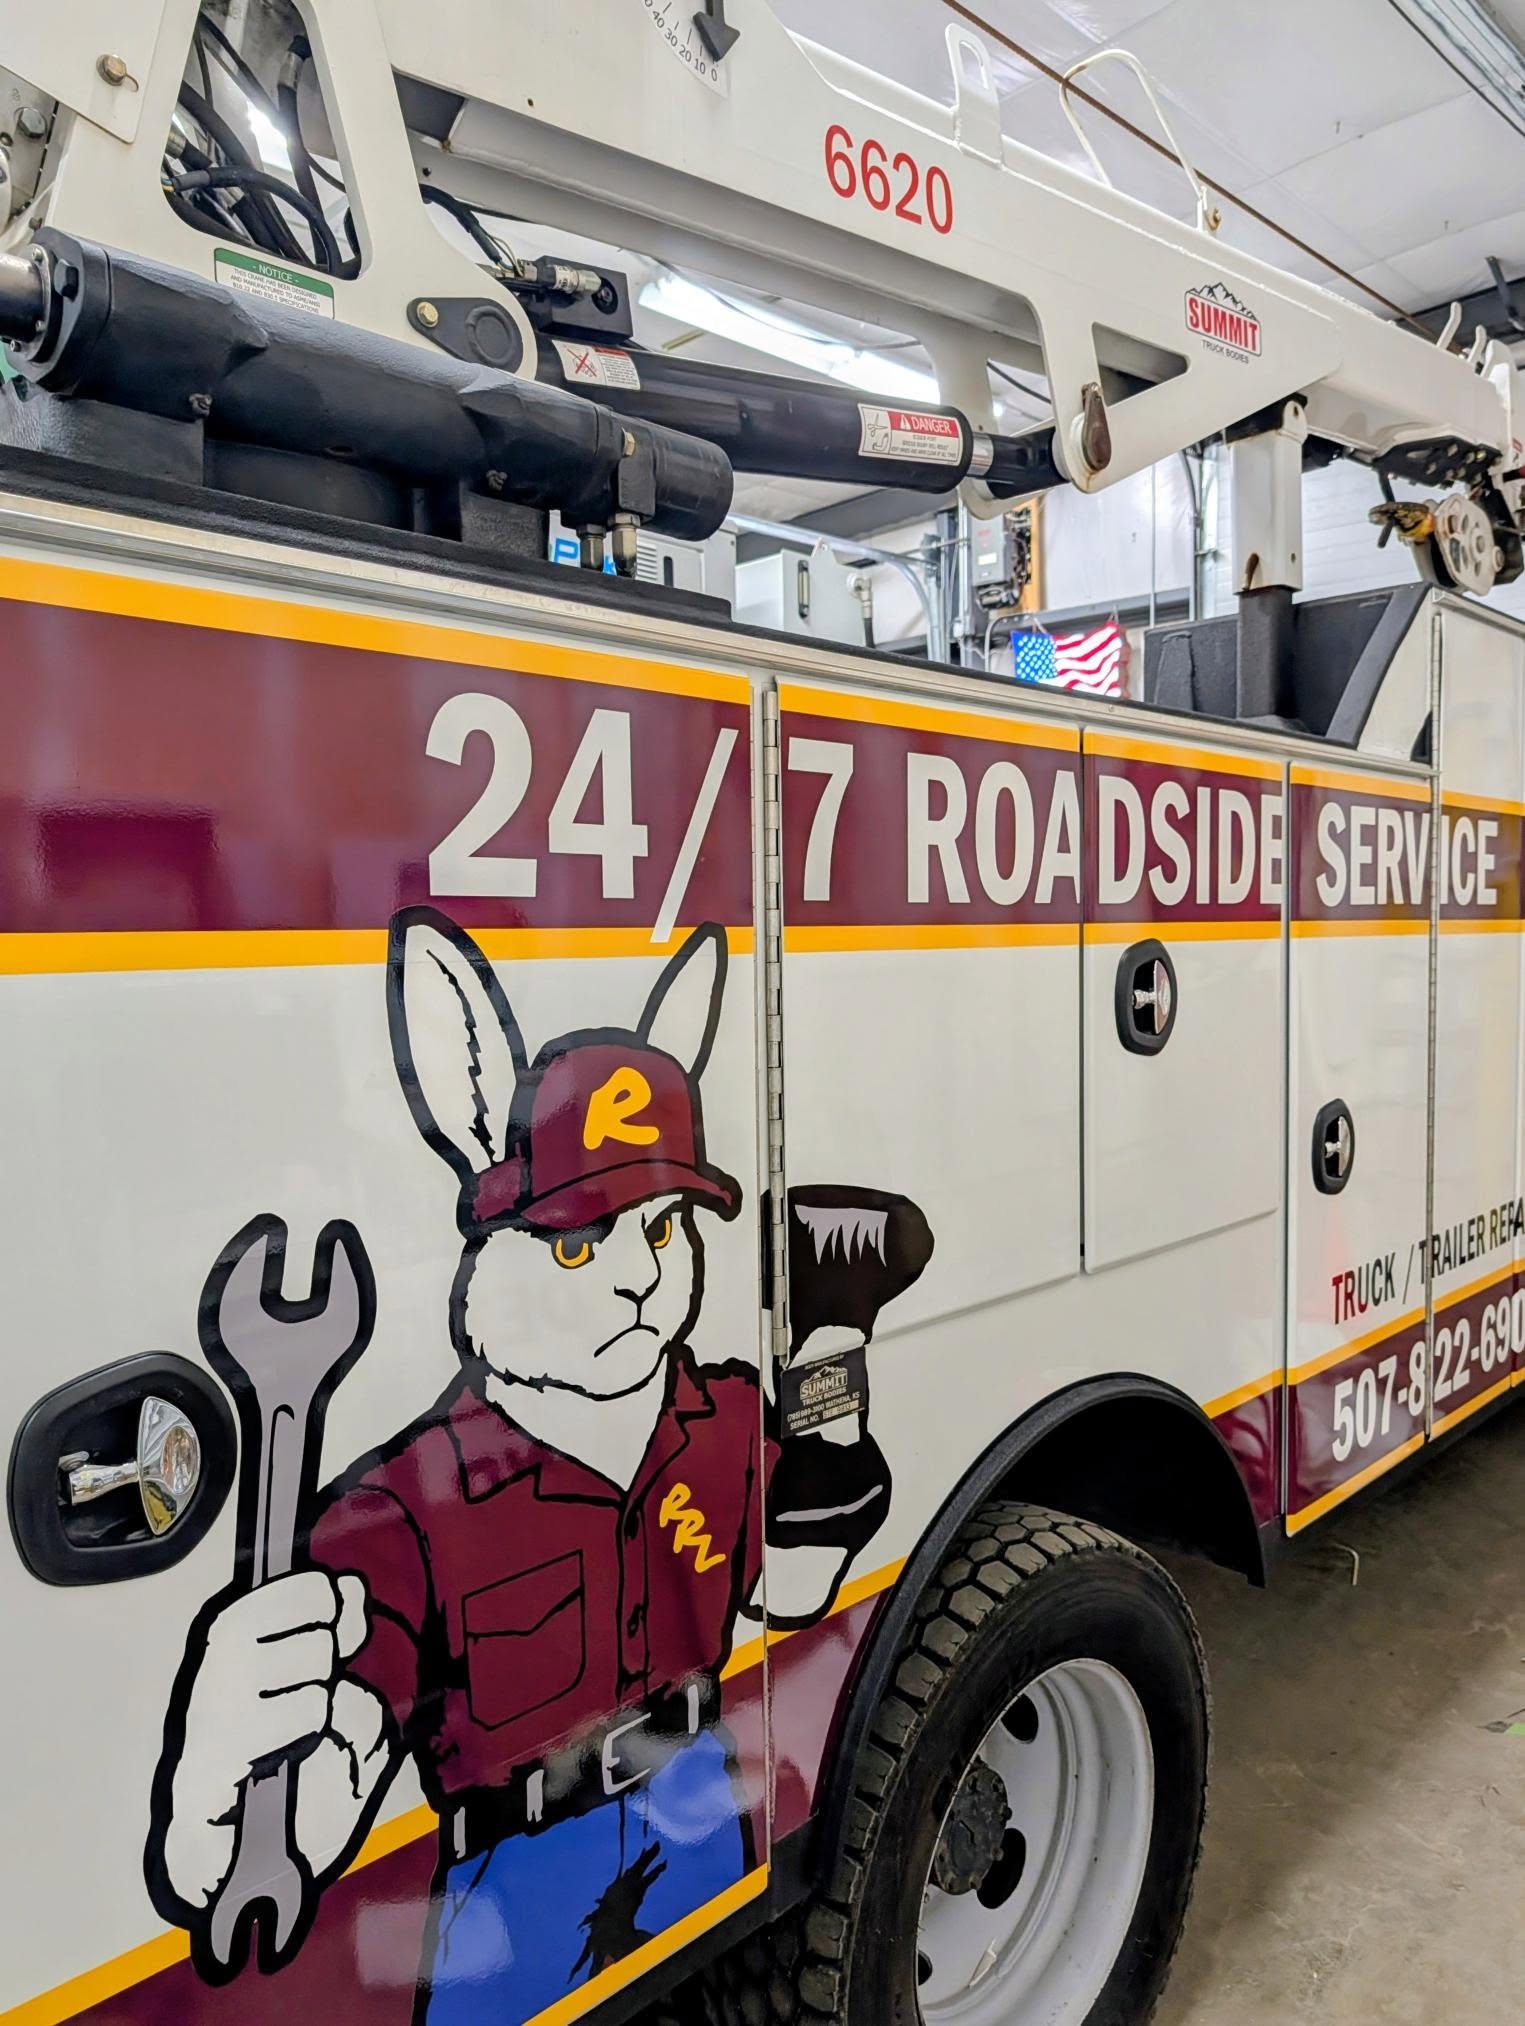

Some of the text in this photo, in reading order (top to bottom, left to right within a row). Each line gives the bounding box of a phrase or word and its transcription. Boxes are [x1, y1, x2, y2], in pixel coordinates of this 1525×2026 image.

[652, 10, 665, 28] 40
[664, 27, 678, 47] 30
[679, 44, 692, 62] 20
[694, 58, 706, 75] 10
[711, 68, 718, 82] 0
[825, 124, 953, 235] 6620
[258, 263, 293, 283] NOTICE
[1188, 297, 1258, 353] SUMMIT
[1201, 339, 1249, 365] TRUCK BODIES
[911, 416, 952, 435] DANGER
[906, 752, 1283, 906] ROADSIDE
[1316, 802, 1499, 907] SERVICE
[583, 1066, 660, 1151] R
[1332, 1252, 1396, 1325] TRUCK
[1419, 1214, 1486, 1285] TRAILER
[801, 1373, 847, 1398] SUMMIT
[802, 1387, 847, 1406] TRUCK BODIES
[790, 1417, 809, 1430] SERIAL
